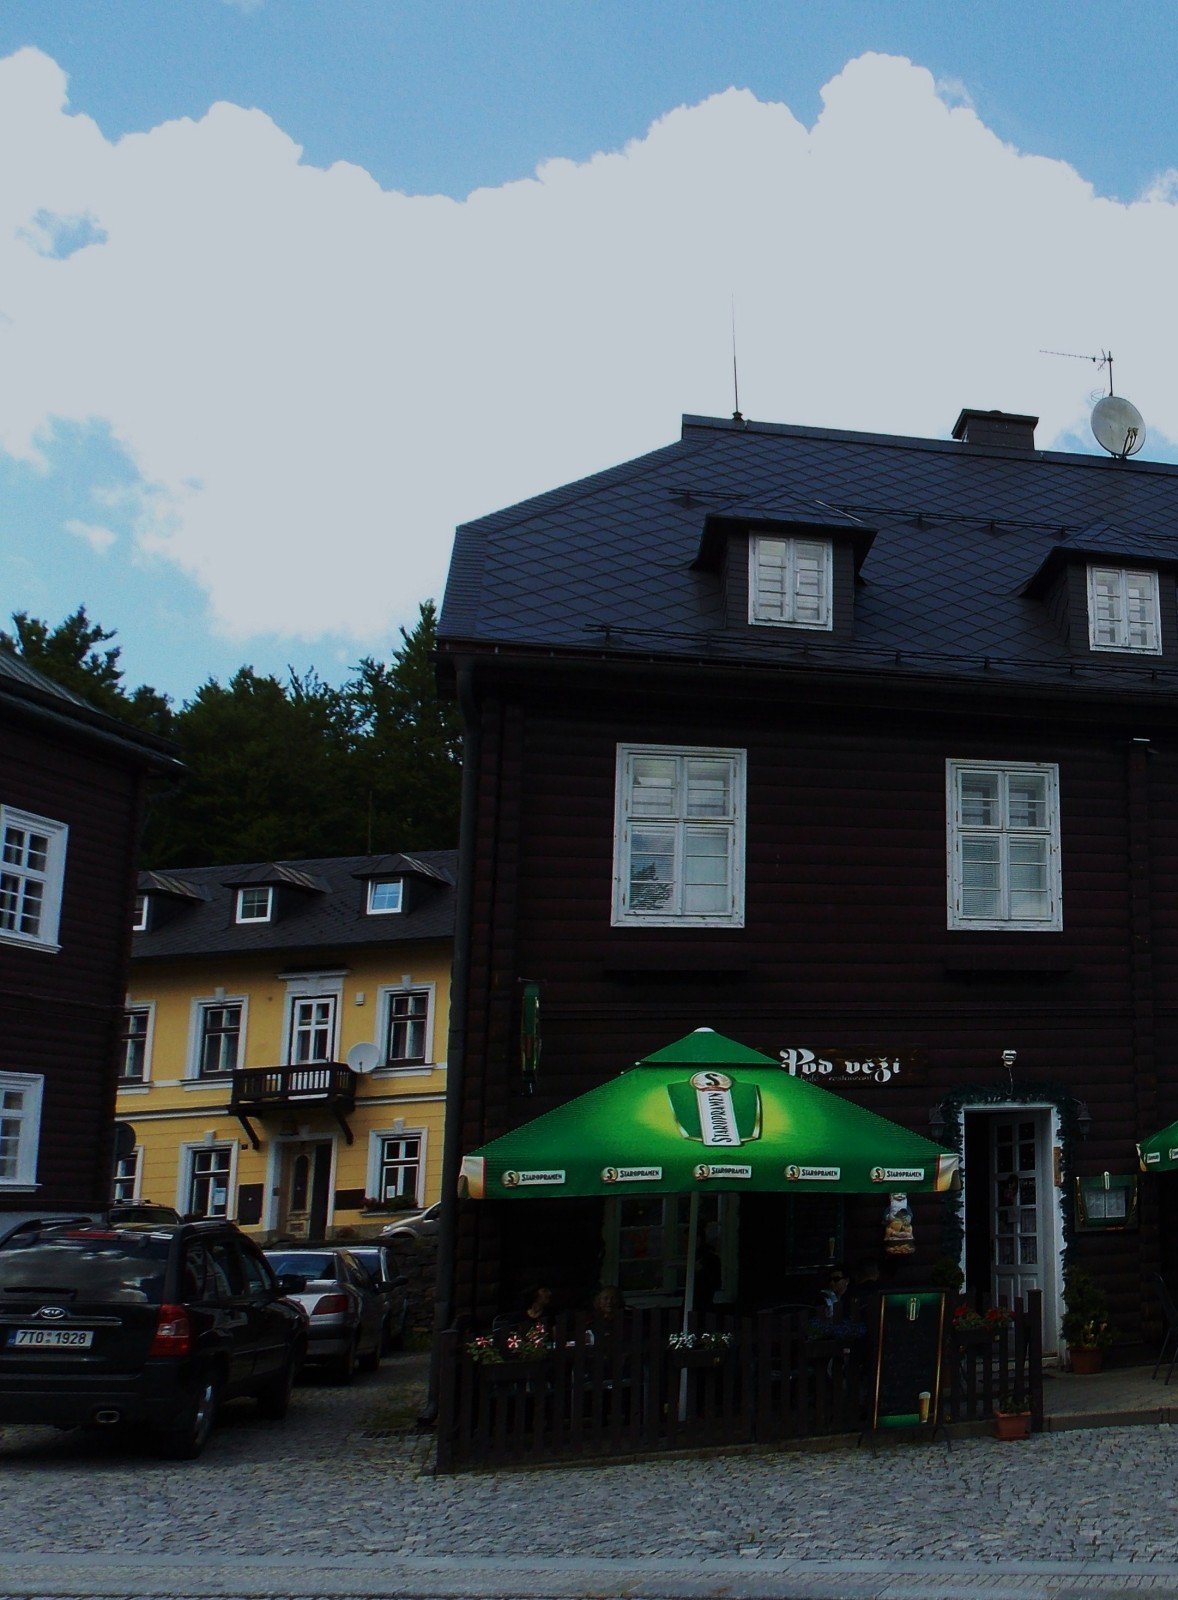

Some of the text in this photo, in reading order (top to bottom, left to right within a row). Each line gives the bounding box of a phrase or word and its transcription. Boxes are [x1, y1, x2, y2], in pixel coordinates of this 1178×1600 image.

[780, 1048, 900, 1083] Pod věži
[708, 1092, 732, 1143] STAROPRAMEN
[521, 1172, 562, 1182] STAROPRAMEN
[620, 1168, 660, 1178] STAROPRAMEN
[55, 1332, 87, 1345] 1928
